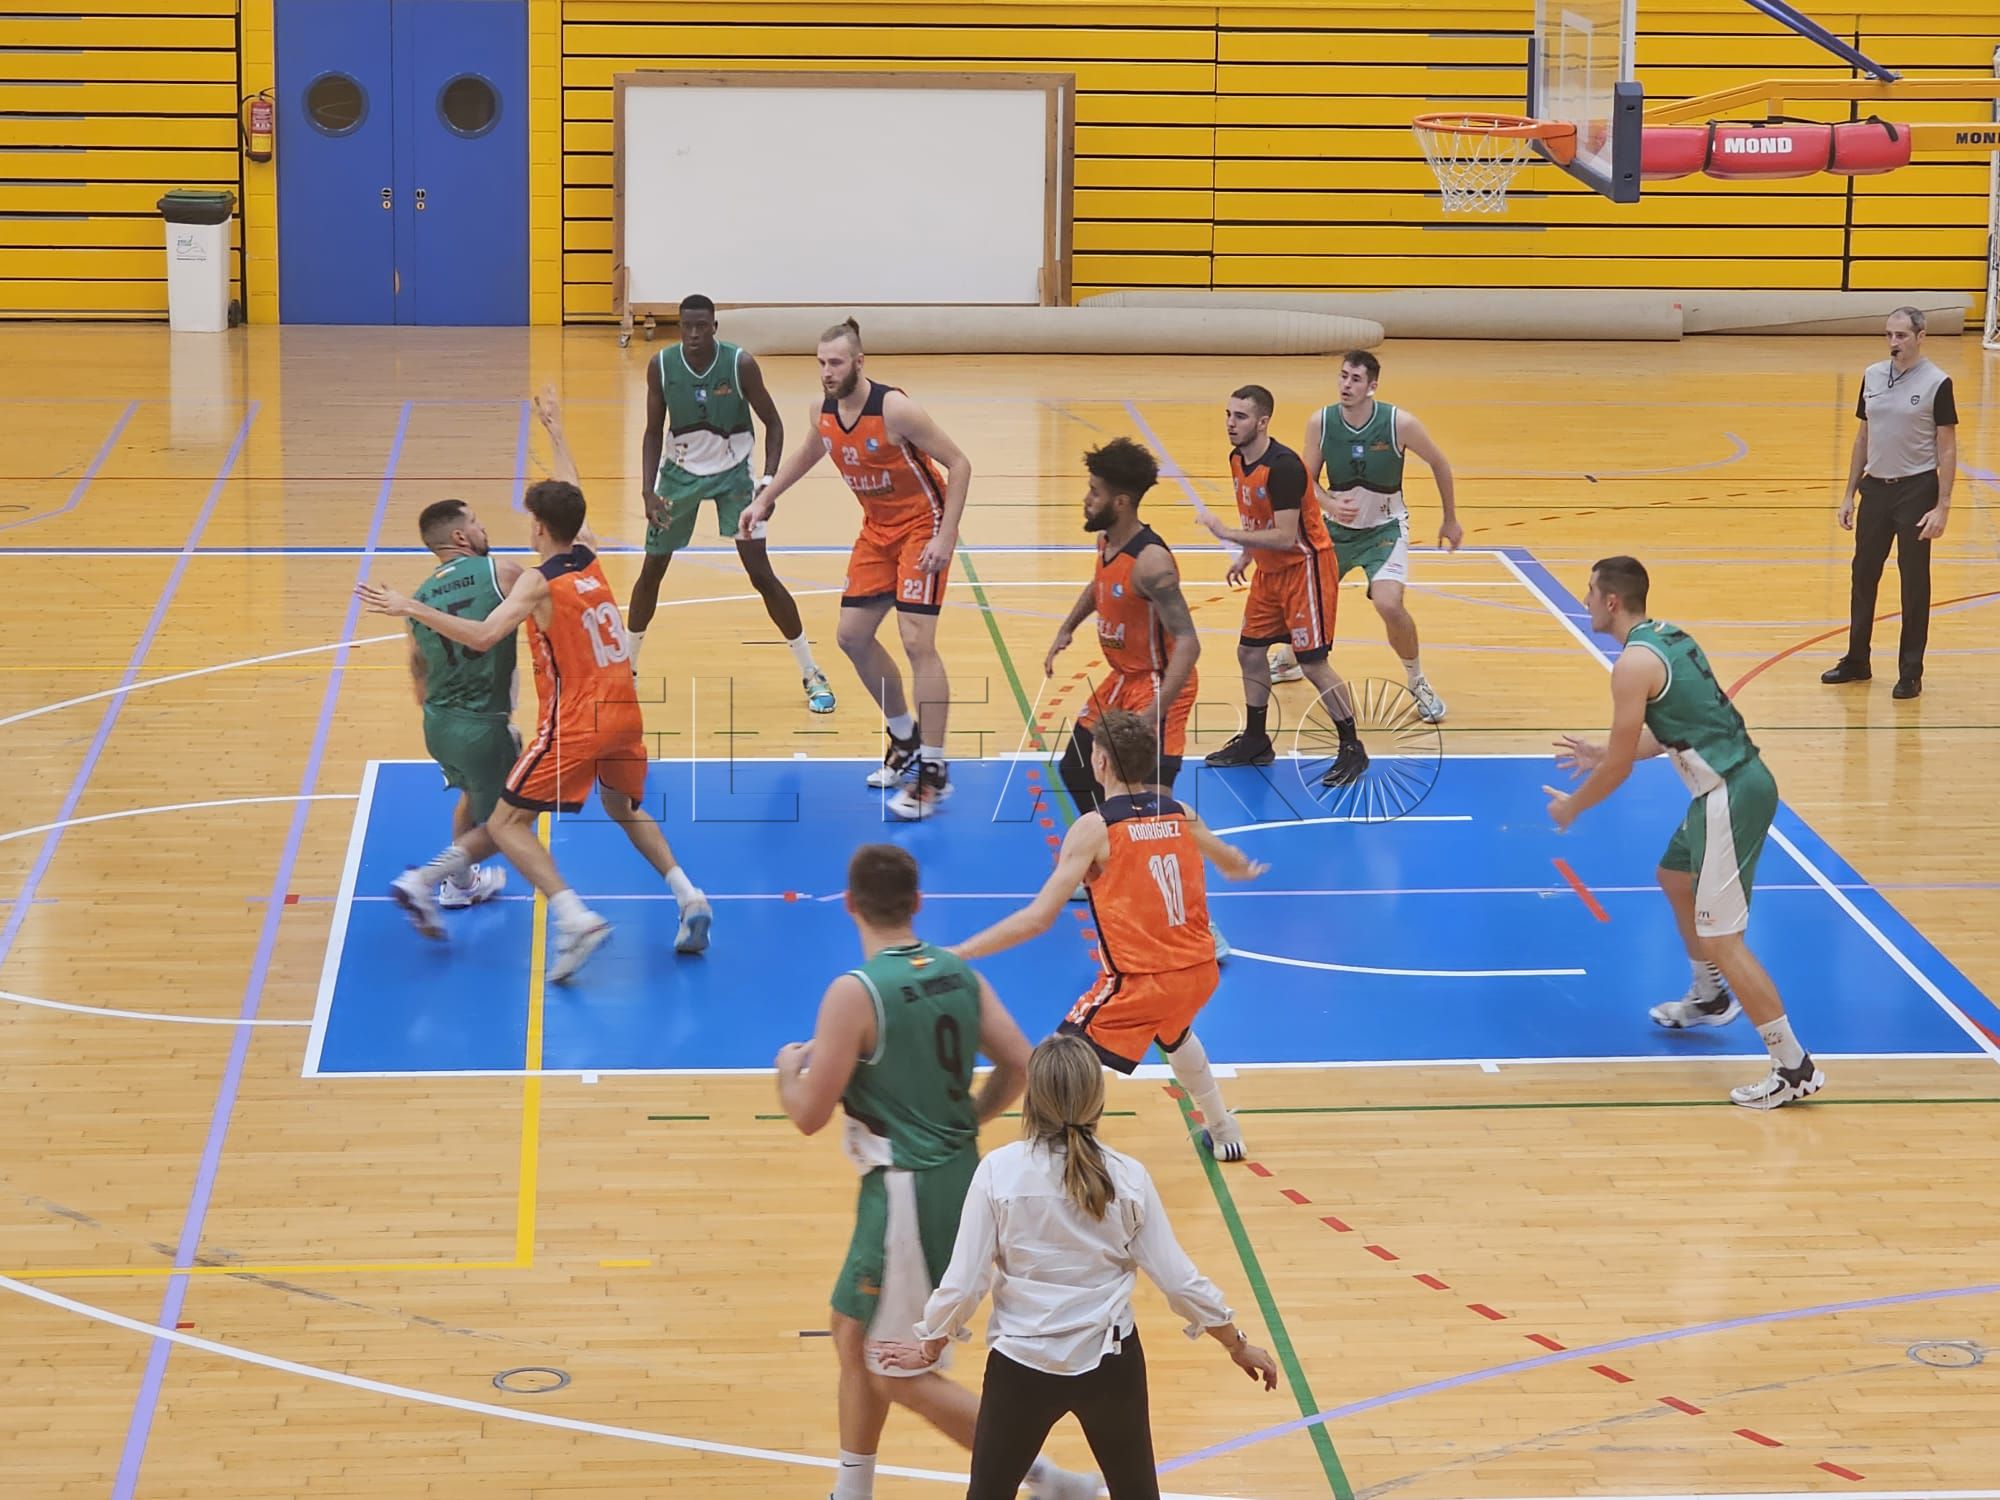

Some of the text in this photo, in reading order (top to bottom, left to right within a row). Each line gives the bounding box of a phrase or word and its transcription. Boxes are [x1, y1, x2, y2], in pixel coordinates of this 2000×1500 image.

[1956, 131, 2000, 145] MON
[902, 578, 924, 600] 22
[581, 600, 630, 669] 13
[1291, 627, 1310, 648] 55
[1127, 817, 1182, 842] RODRÍGUEZ
[1148, 853, 1187, 928] 11
[935, 1013, 964, 1102] 9
